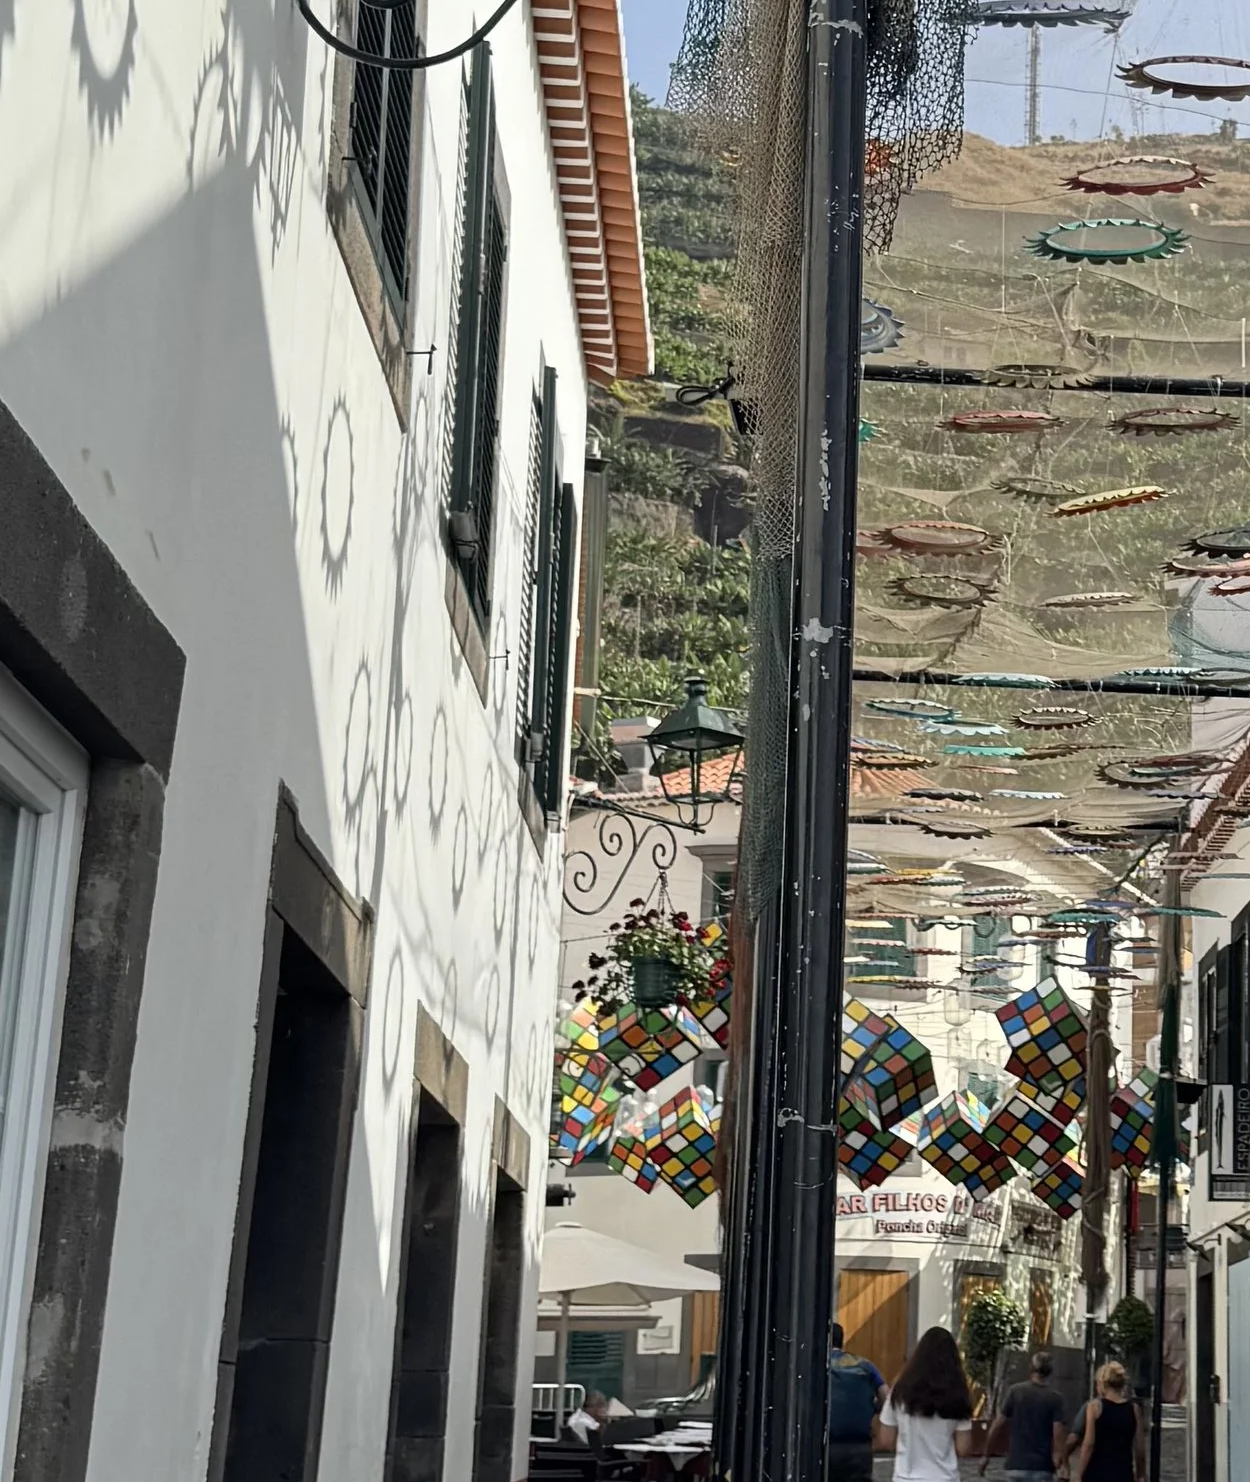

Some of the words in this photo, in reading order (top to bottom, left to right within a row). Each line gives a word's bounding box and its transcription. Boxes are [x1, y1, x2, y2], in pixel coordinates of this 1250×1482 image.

[1237, 1087, 1250, 1171] ESPADEIRO
[836, 1195, 868, 1215] AR
[873, 1192, 948, 1213] FILHOS
[876, 1219, 923, 1233] Poncha
